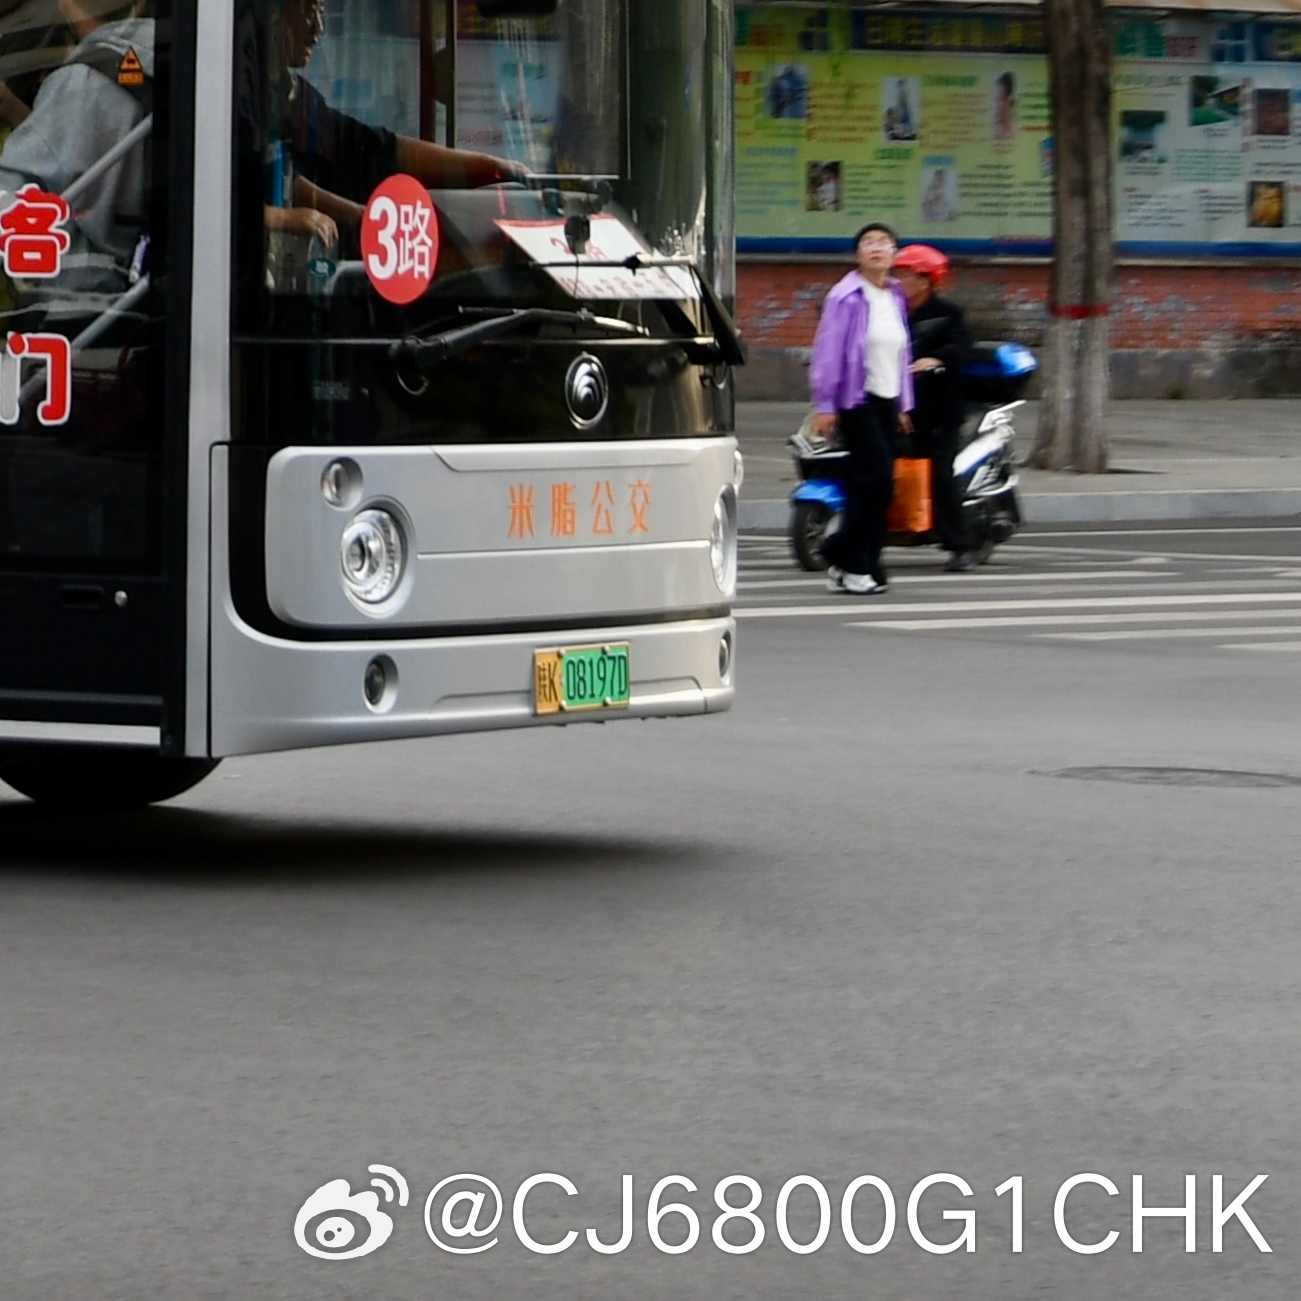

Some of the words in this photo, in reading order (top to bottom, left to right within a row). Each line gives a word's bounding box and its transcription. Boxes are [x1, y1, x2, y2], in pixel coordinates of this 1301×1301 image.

[367, 194, 435, 281] 3路
[507, 479, 652, 539] 米脂公交
